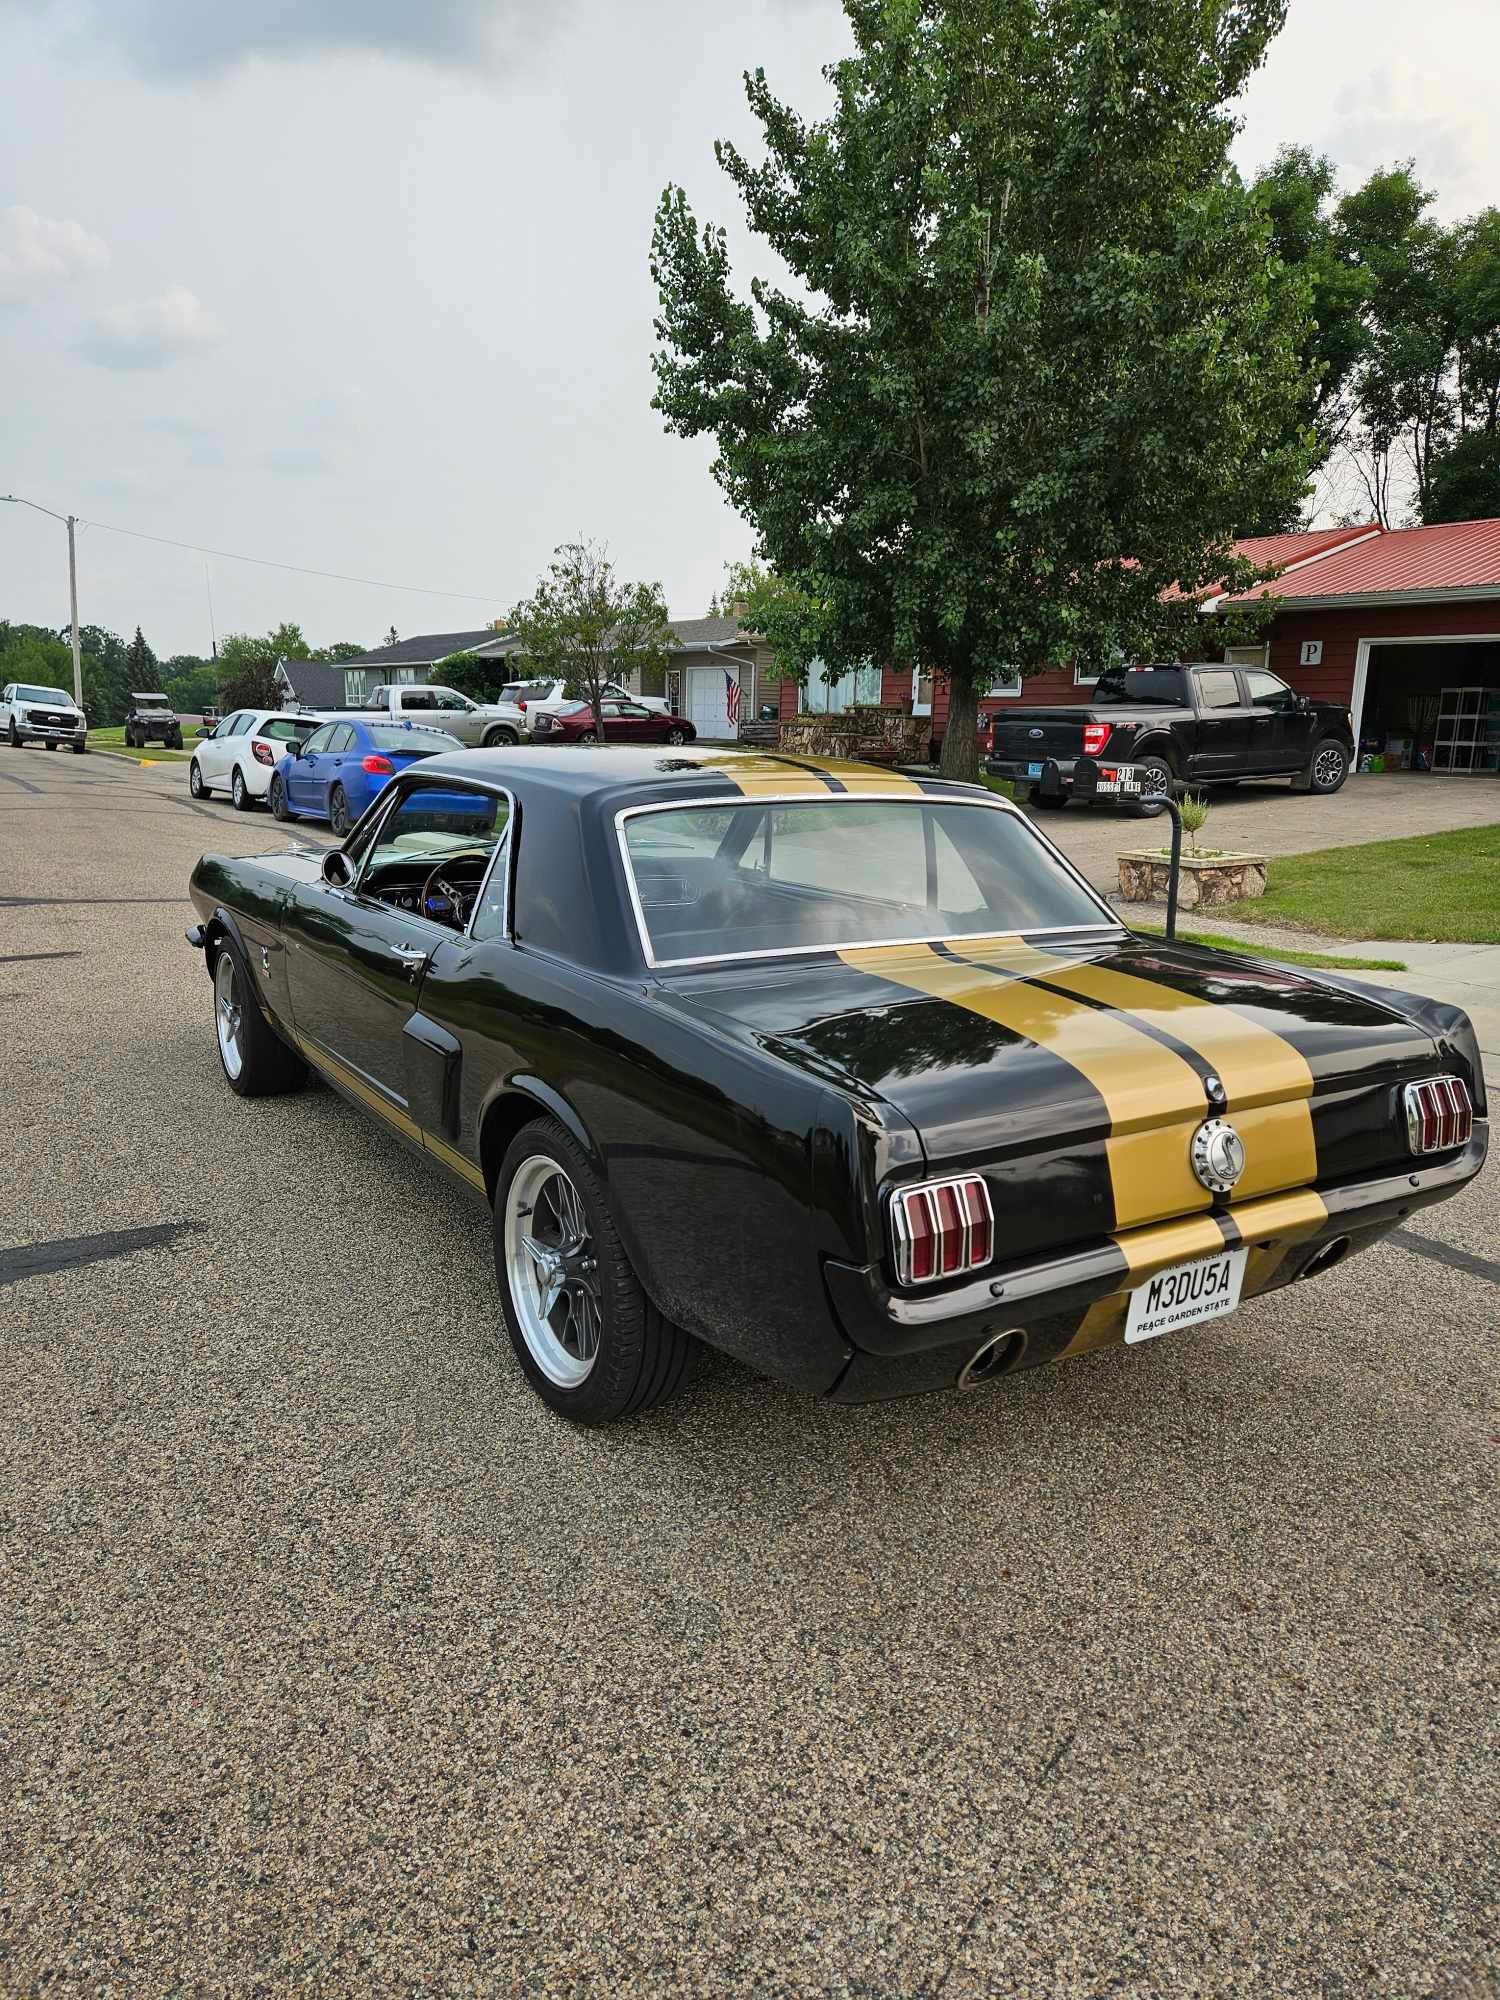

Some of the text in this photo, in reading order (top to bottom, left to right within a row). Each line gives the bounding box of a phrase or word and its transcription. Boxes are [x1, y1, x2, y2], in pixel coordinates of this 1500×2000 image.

[1304, 644, 1318, 661] P
[1117, 768, 1134, 781] 213
[1124, 782, 1141, 792] LANE
[1145, 1260, 1231, 1314] M3DU5A
[1136, 1298, 1231, 1333] PEACE GARDEN STATE
